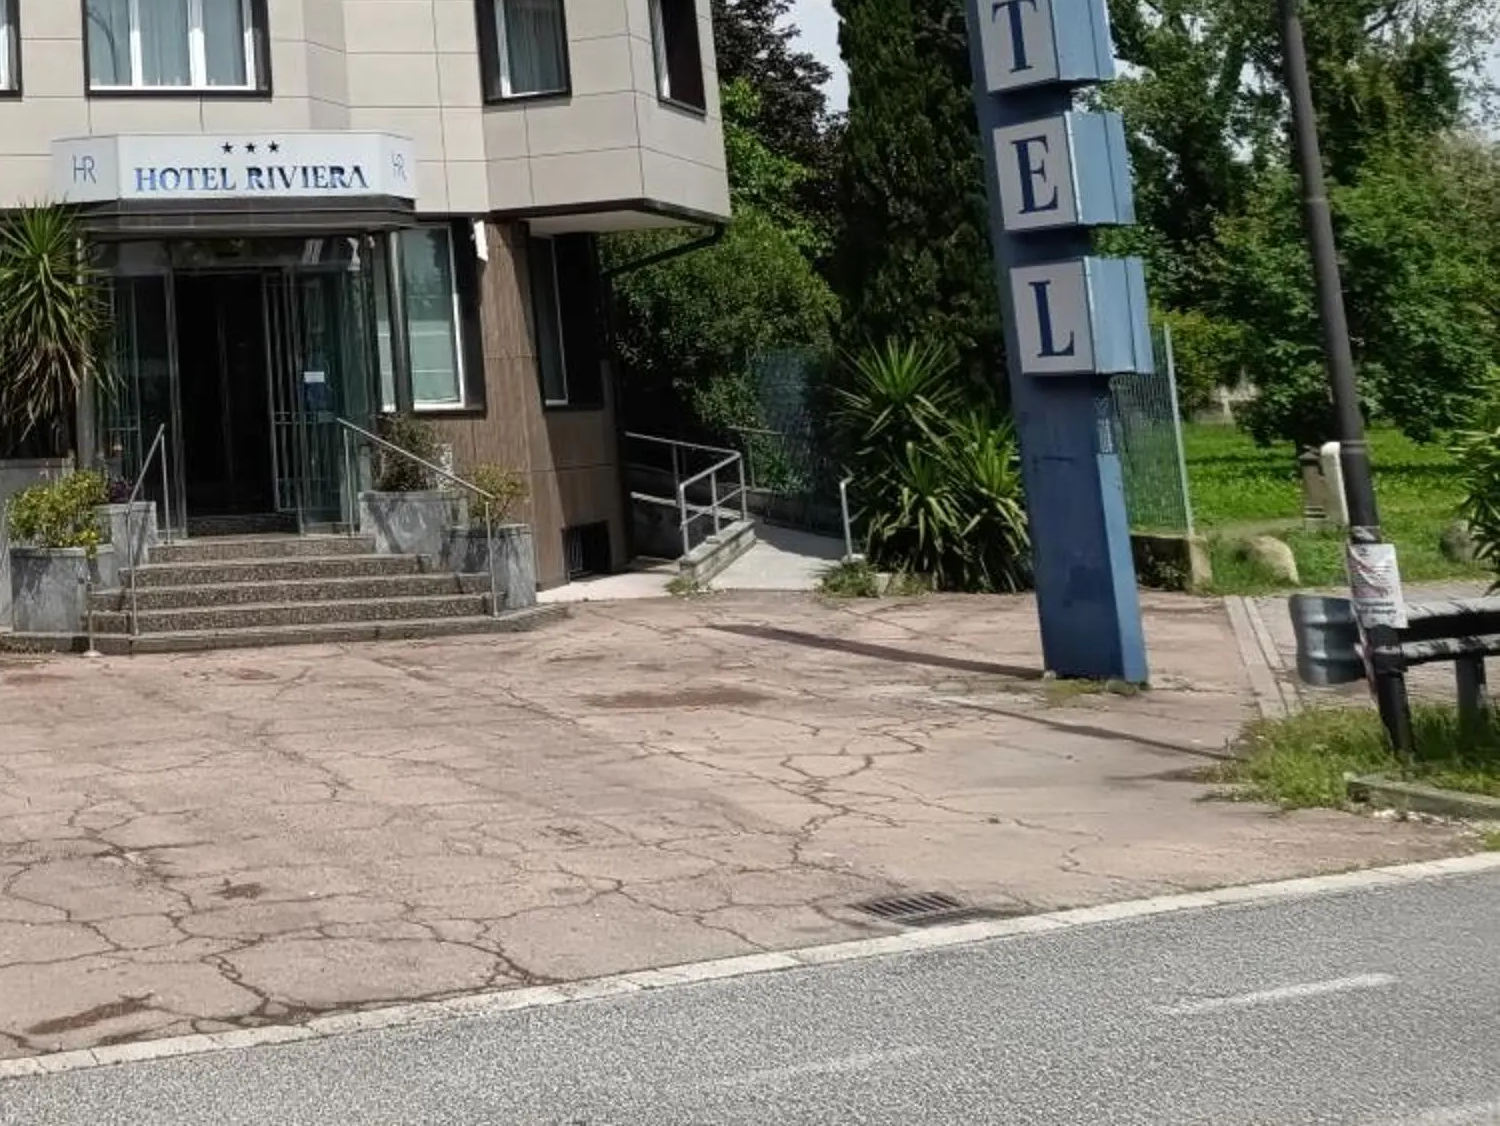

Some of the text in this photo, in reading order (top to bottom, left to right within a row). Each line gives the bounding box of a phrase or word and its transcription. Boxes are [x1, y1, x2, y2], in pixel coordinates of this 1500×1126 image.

[72, 154, 97, 185] HR
[133, 164, 370, 192] HOTEL RIVIERA
